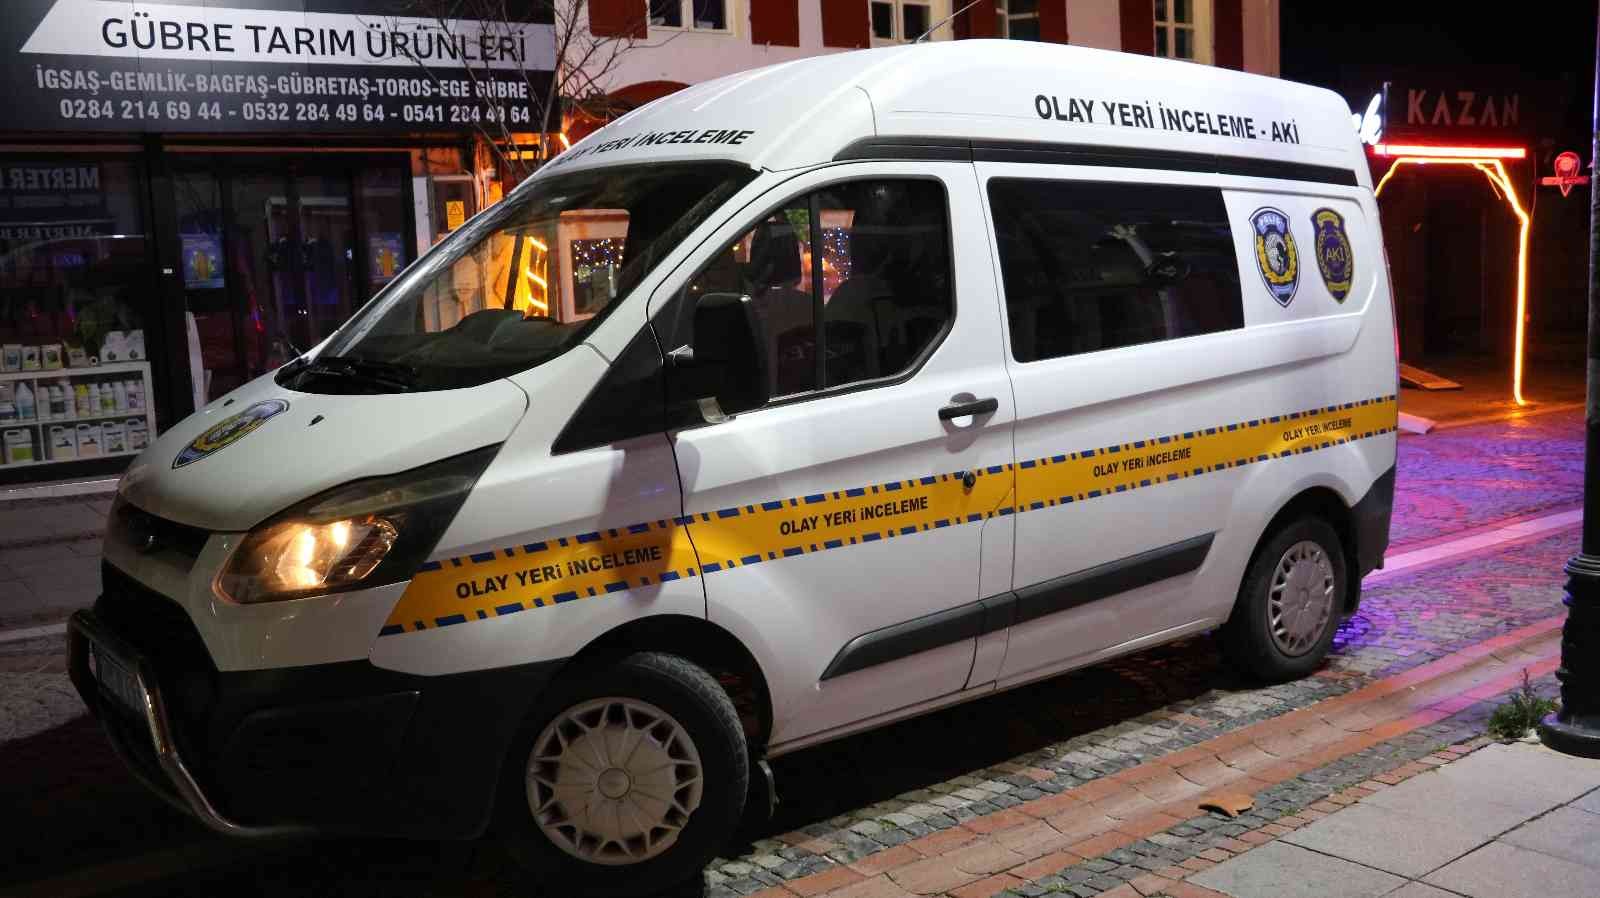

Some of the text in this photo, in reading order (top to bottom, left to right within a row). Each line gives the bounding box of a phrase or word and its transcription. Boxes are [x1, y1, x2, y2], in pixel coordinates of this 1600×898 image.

[102, 11, 526, 62] GÜBRE TARIM ÜRÜNLERİ
[60, 99, 114, 119] 0284
[121, 100, 160, 120] 214
[166, 101, 191, 120] 69
[198, 102, 222, 120] 44
[243, 102, 290, 121] 0532
[296, 103, 330, 121] 284
[336, 103, 357, 122] 49
[363, 104, 385, 122] 64
[403, 105, 444, 122] 0541
[511, 106, 530, 123] 64
[1035, 94, 1095, 124] OLAY
[1102, 100, 1155, 129] YERİ
[1158, 101, 1257, 140] İNCELEME
[1407, 89, 1518, 127] KAZAN
[1282, 427, 1304, 441] OLAY
[1093, 461, 1120, 478] OLAY
[779, 515, 819, 536] OLAY
[456, 574, 509, 600] OLAY
